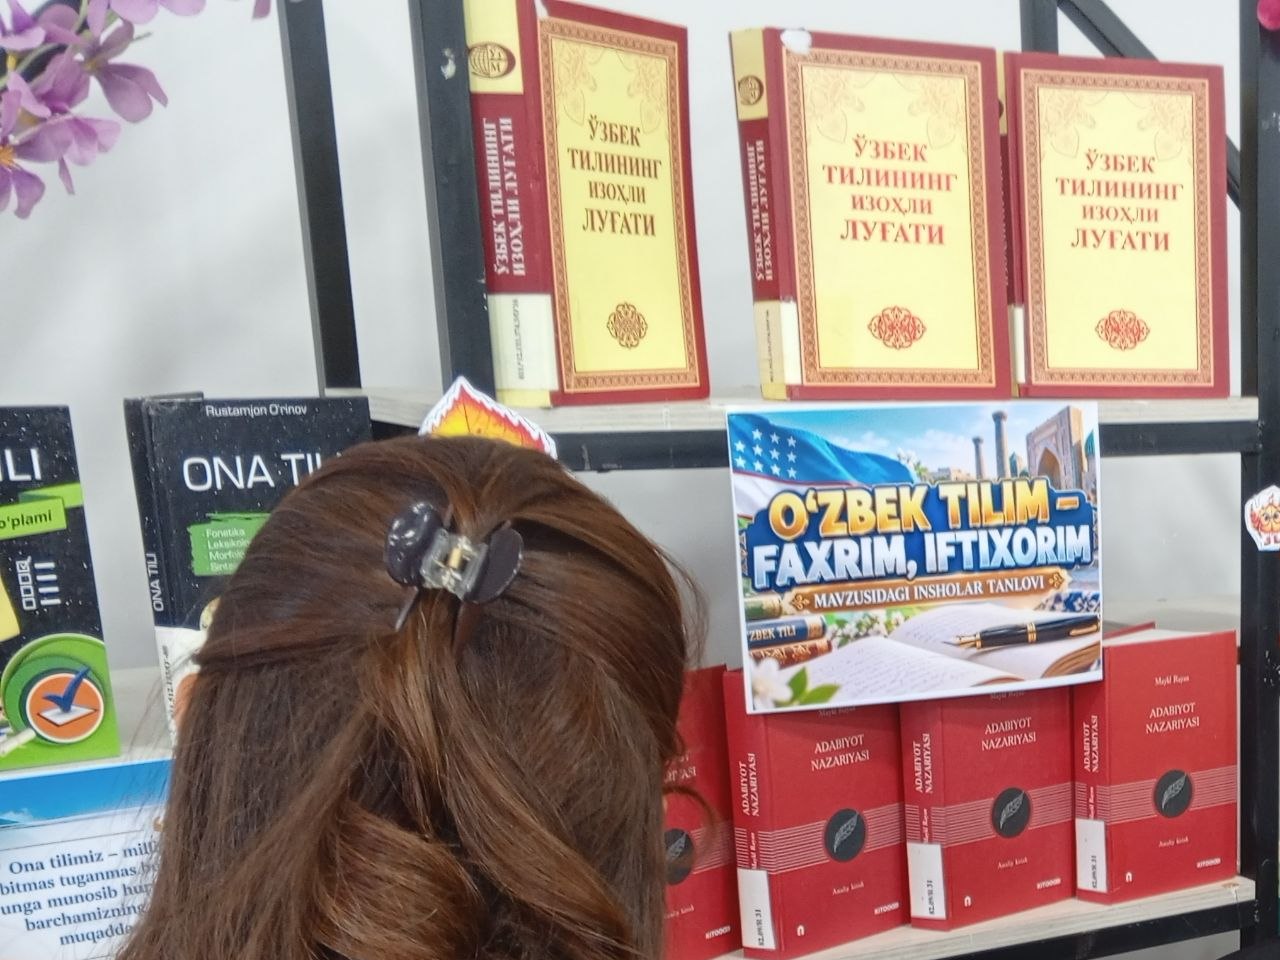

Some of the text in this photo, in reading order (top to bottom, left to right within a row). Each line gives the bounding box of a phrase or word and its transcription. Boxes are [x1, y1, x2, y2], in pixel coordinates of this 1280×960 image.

[588, 115, 641, 147] ЎЗБЕК
[499, 117, 519, 197] ЛУҒАТИ
[852, 133, 928, 163] ЎЗБЕК
[1086, 148, 1156, 173] ЎЗБЕК
[567, 148, 662, 179] ТИЛИНИНГ
[822, 164, 958, 192] ТИЛИНИНГ
[483, 118, 510, 277] ЎЗБЕК ТИЛИНИНГ
[588, 181, 646, 205] ИЗОҲЛИ
[1055, 176, 1184, 200] ТИЛИНИНГ
[851, 194, 933, 216] ИЗОҲЛИ
[1081, 204, 1159, 225] ИЗОҲЛИ
[582, 207, 656, 237] ЛУҒАТИ
[840, 218, 945, 245] ЛУҒАТИ
[507, 199, 526, 277] ИЗОҲЛИ
[1070, 227, 1169, 251] ЛУҒАТИ
[206, 405, 267, 418] Rustamjon
[0, 448, 41, 481] LI
[183, 454, 275, 491] ONA
[938, 478, 1050, 530] TILIM
[752, 523, 1093, 590] FAXRIM, IFTIXORIM
[145, 552, 164, 611] ONA TILI
[813, 575, 1045, 609] MAVZUSIDAGI INSHOLAR TANLOVI
[1145, 717, 1200, 734] NAZARIYASI
[1149, 702, 1196, 719] ADABIYOT
[981, 731, 1037, 751] NAZARIYASI
[985, 717, 1032, 735] ADABIYOT
[814, 734, 865, 754] ADABIYOT
[1083, 722, 1091, 771] ADABIYOT
[1091, 715, 1099, 773] NAZARIYASI
[811, 750, 870, 771] NAZARIYASI
[912, 741, 923, 793] ADABIYOT
[922, 733, 933, 794] NAZARIYASI
[739, 762, 750, 815] ADABIYOT
[747, 753, 760, 817] NAZARIYASI
[9, 861, 45, 875] Ona
[50, 850, 104, 868] tilimiz
[0, 878, 55, 895] bitmas
[60, 866, 137, 888] tuganmas
[1, 900, 42, 915] unga
[47, 887, 118, 908] munosib
